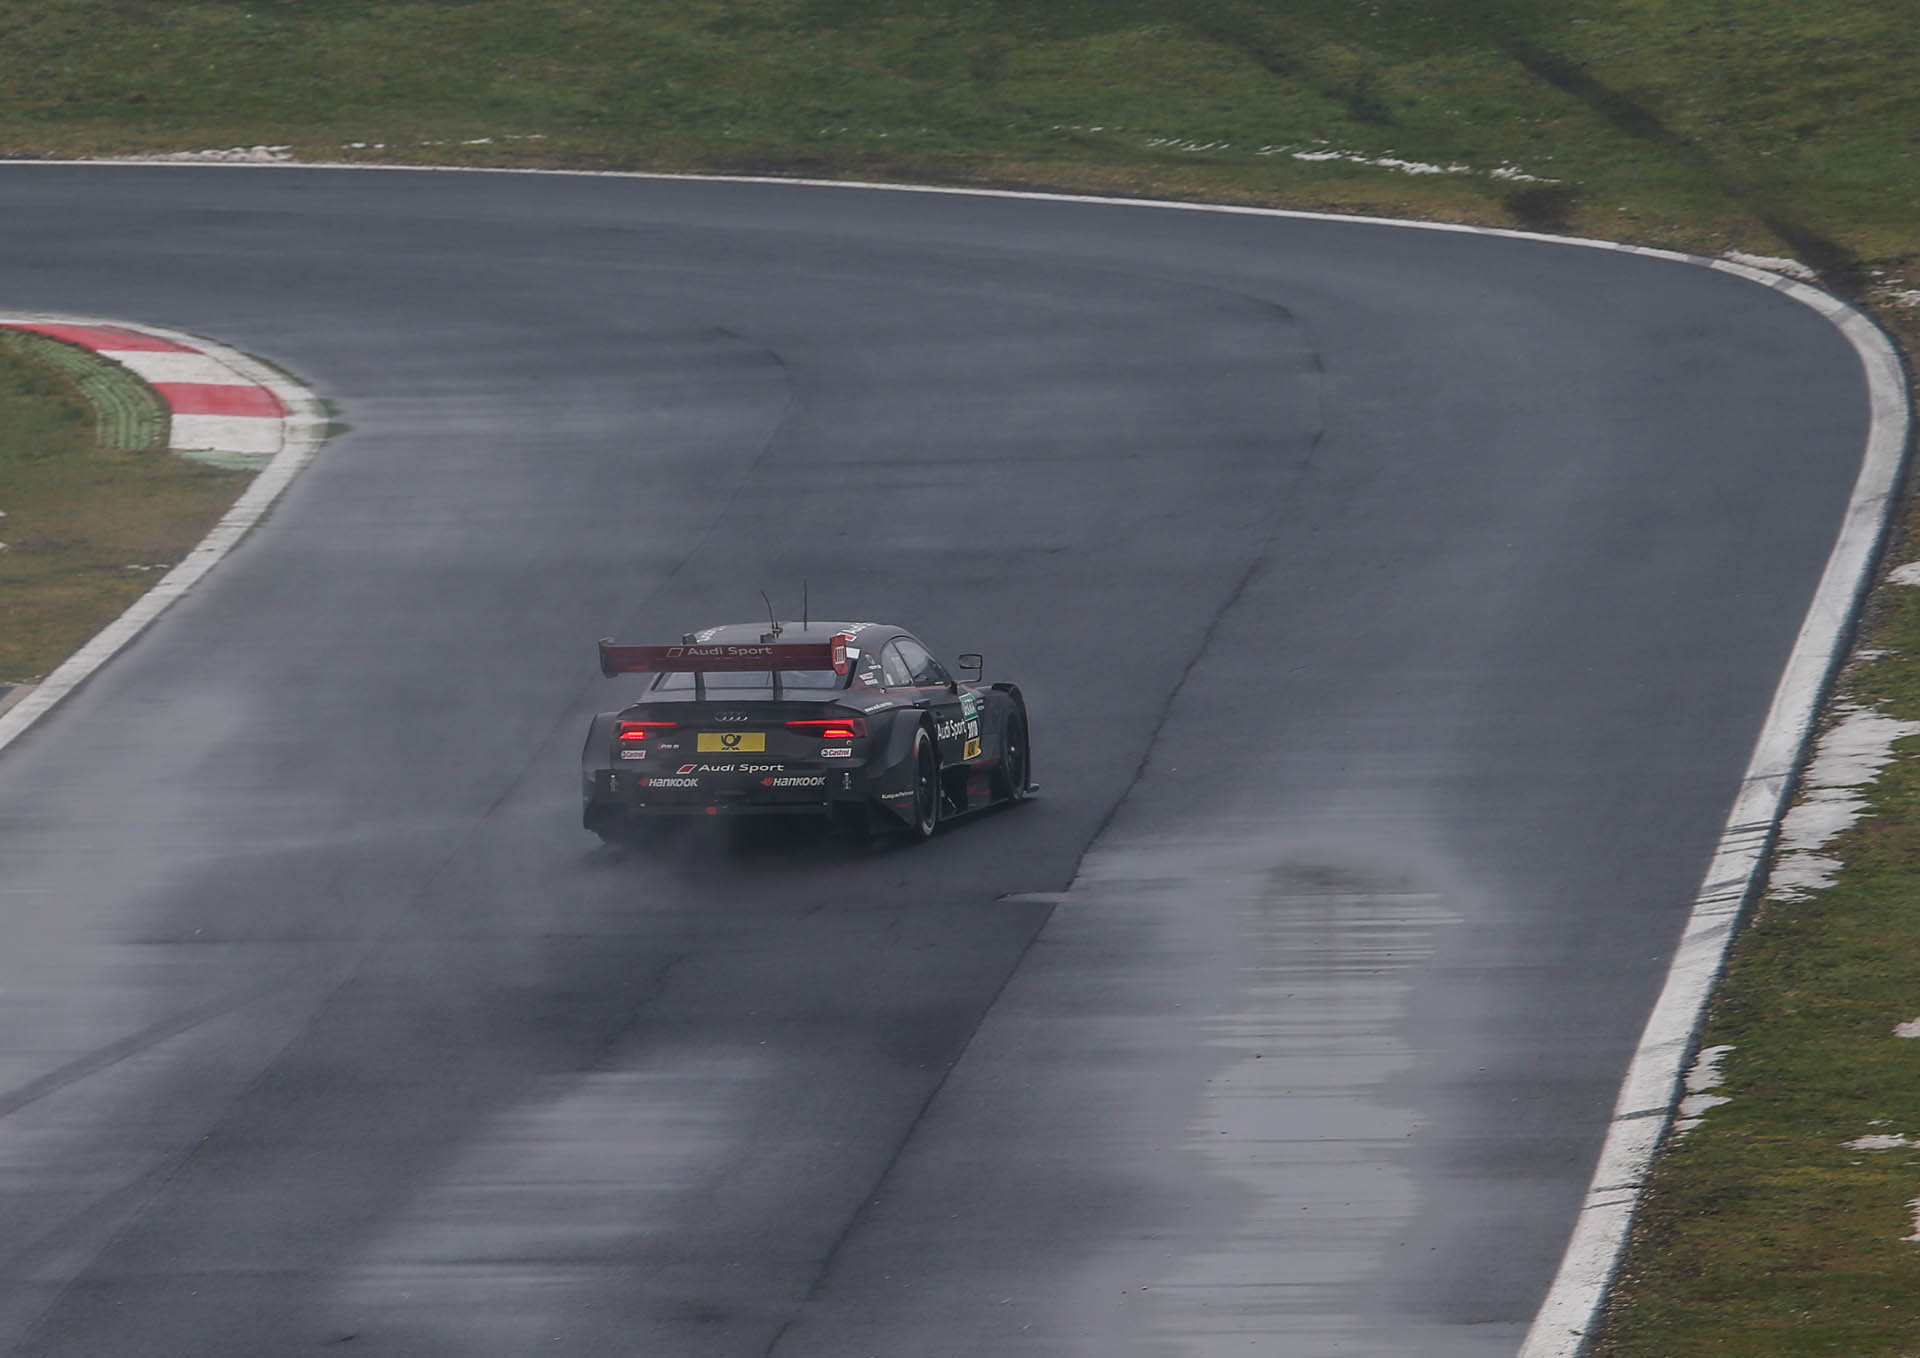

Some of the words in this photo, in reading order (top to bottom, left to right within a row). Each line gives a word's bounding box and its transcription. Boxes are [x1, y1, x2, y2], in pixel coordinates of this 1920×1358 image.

[687, 646, 724, 656] Audi
[728, 646, 773, 657] Sport
[937, 720, 951, 741] Audi
[950, 719, 967, 741] Sport
[827, 748, 851, 757] Castrol
[699, 763, 735, 772] Audi
[739, 763, 785, 774] Sport
